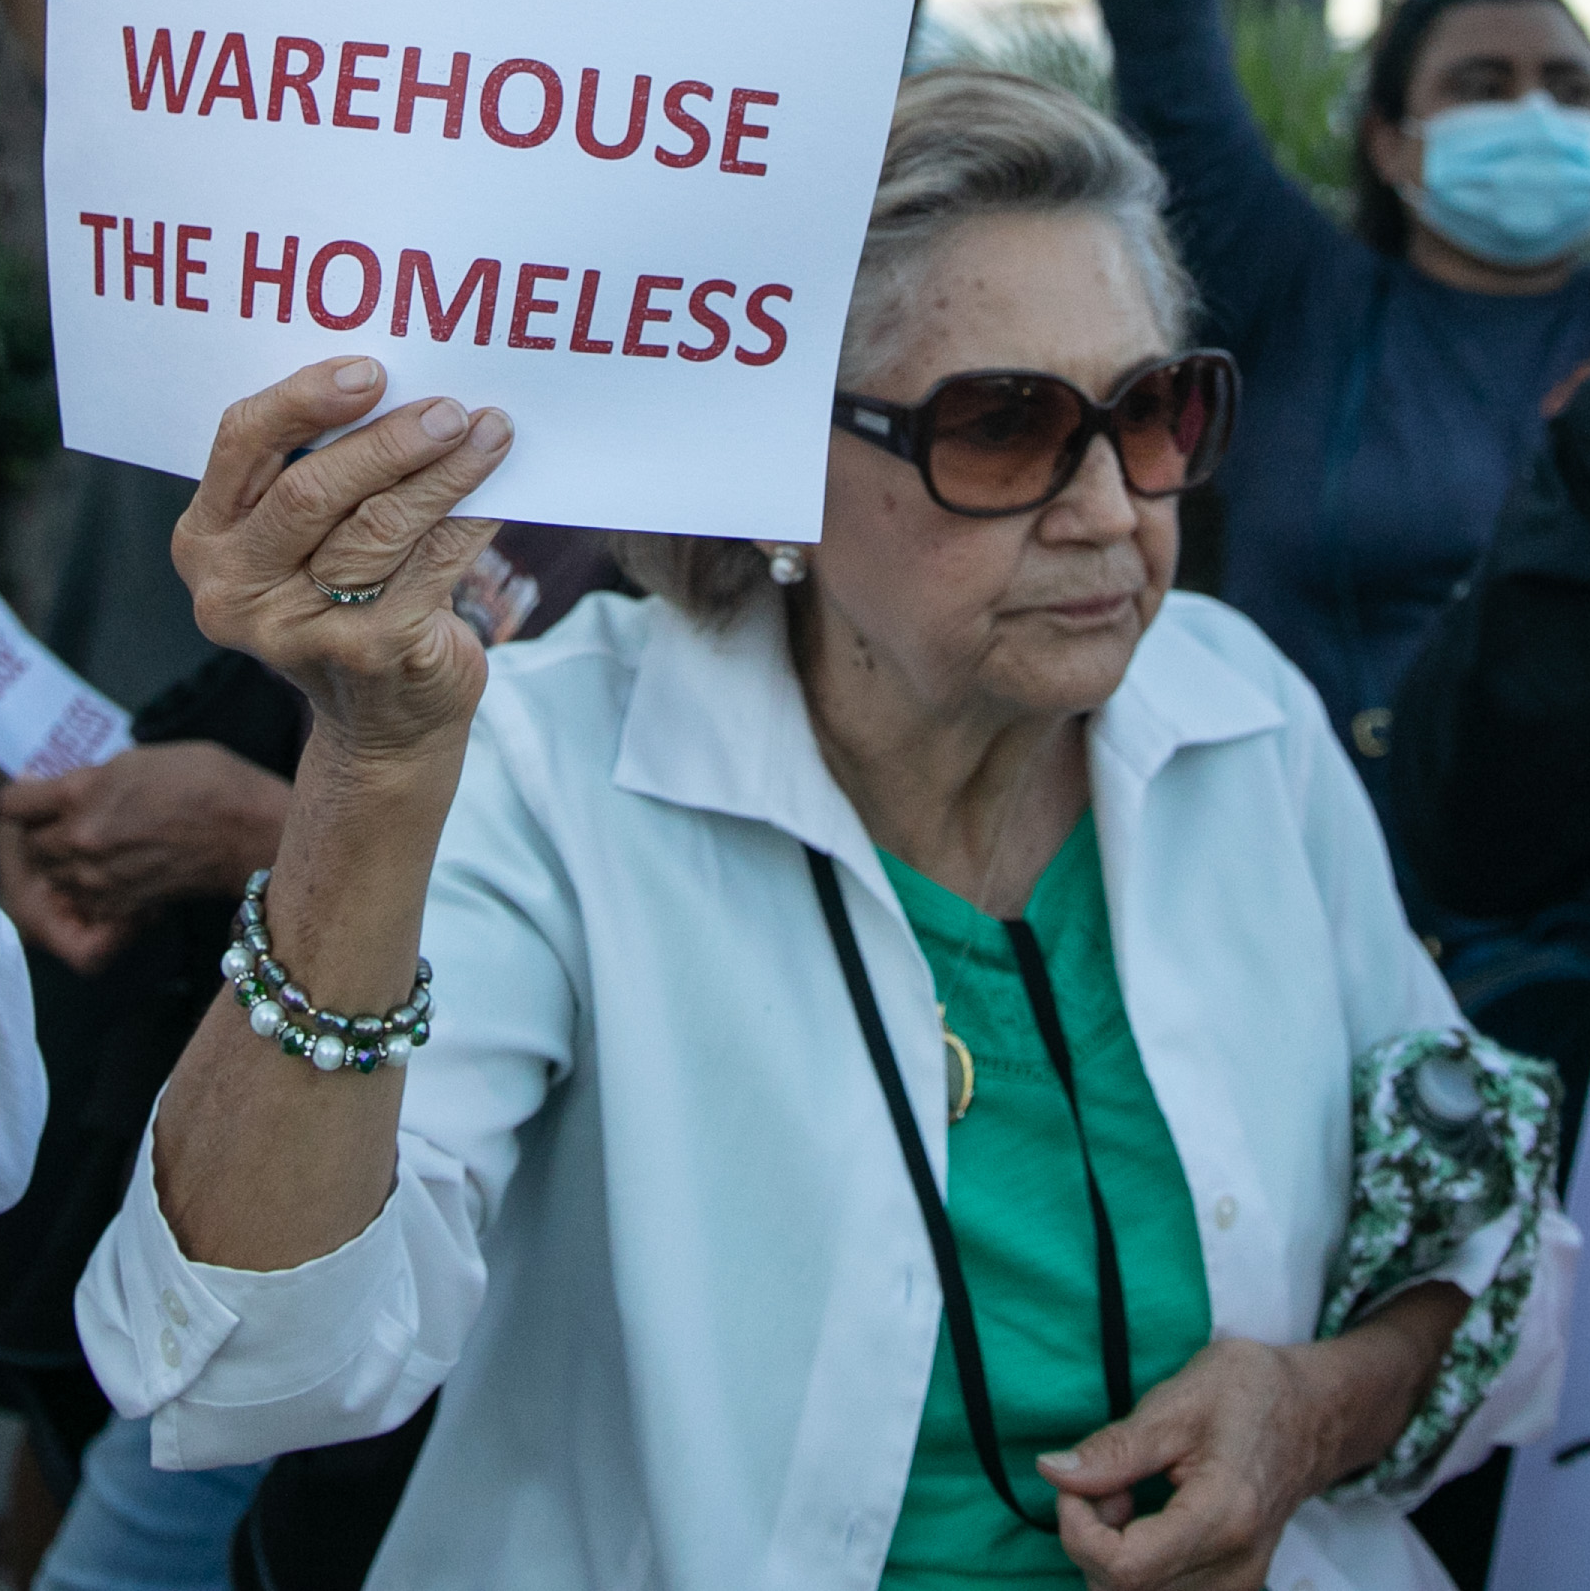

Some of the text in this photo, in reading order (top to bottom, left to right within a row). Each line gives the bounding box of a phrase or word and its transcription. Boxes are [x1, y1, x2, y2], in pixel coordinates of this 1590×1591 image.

[121, 25, 780, 177] WAREHOUSE
[79, 211, 793, 367] THE HOMELESS
